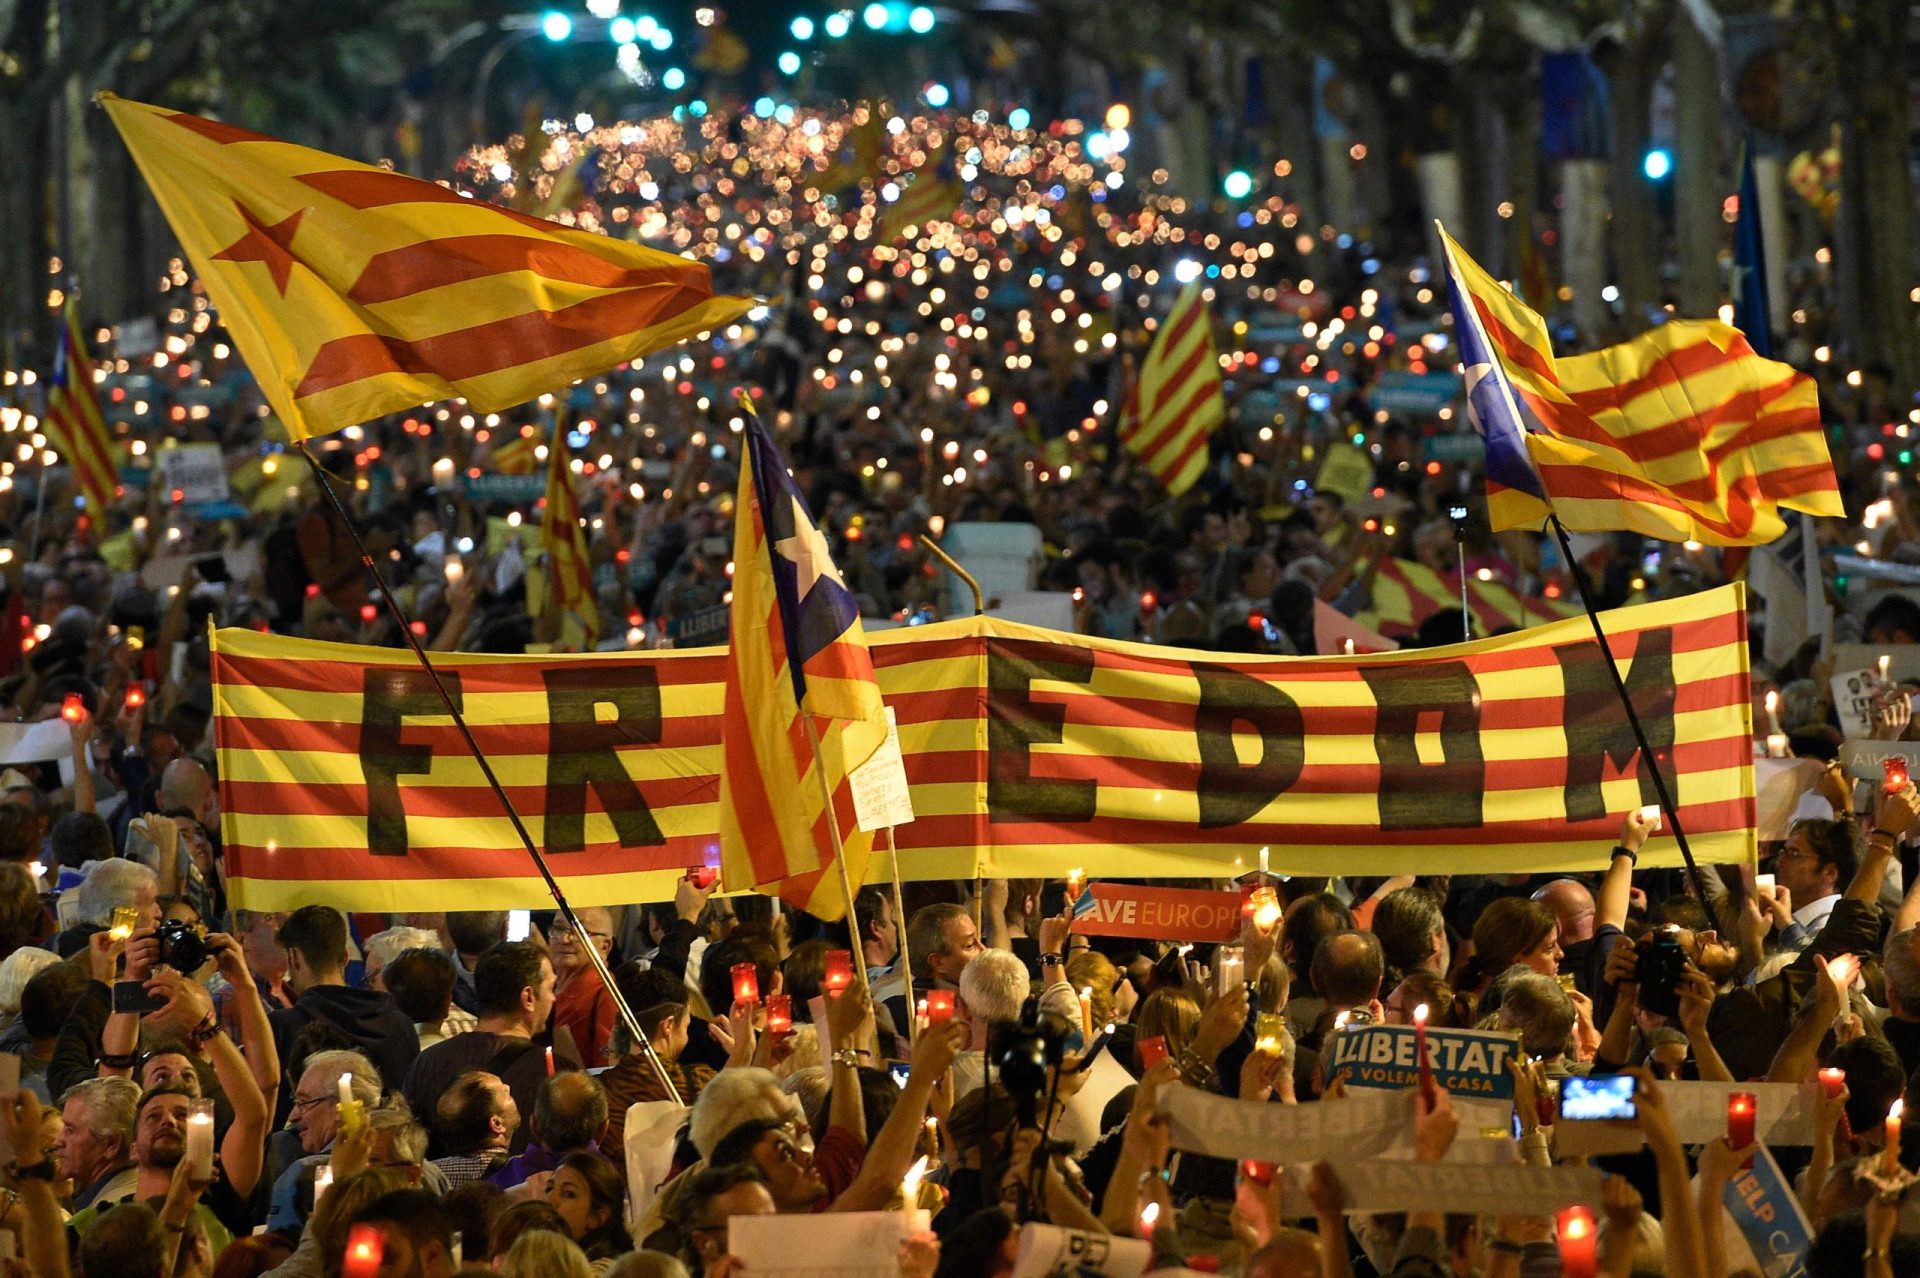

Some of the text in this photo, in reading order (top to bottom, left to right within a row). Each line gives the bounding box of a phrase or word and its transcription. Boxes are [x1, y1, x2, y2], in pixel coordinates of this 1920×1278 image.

[359, 627, 1680, 857] FREDOM
[1083, 898, 1137, 924] AVE
[1334, 1032, 1510, 1075] LLIBERTAT
[1361, 1067, 1419, 1086] VOLEM
[1446, 1075, 1493, 1092] CASA
